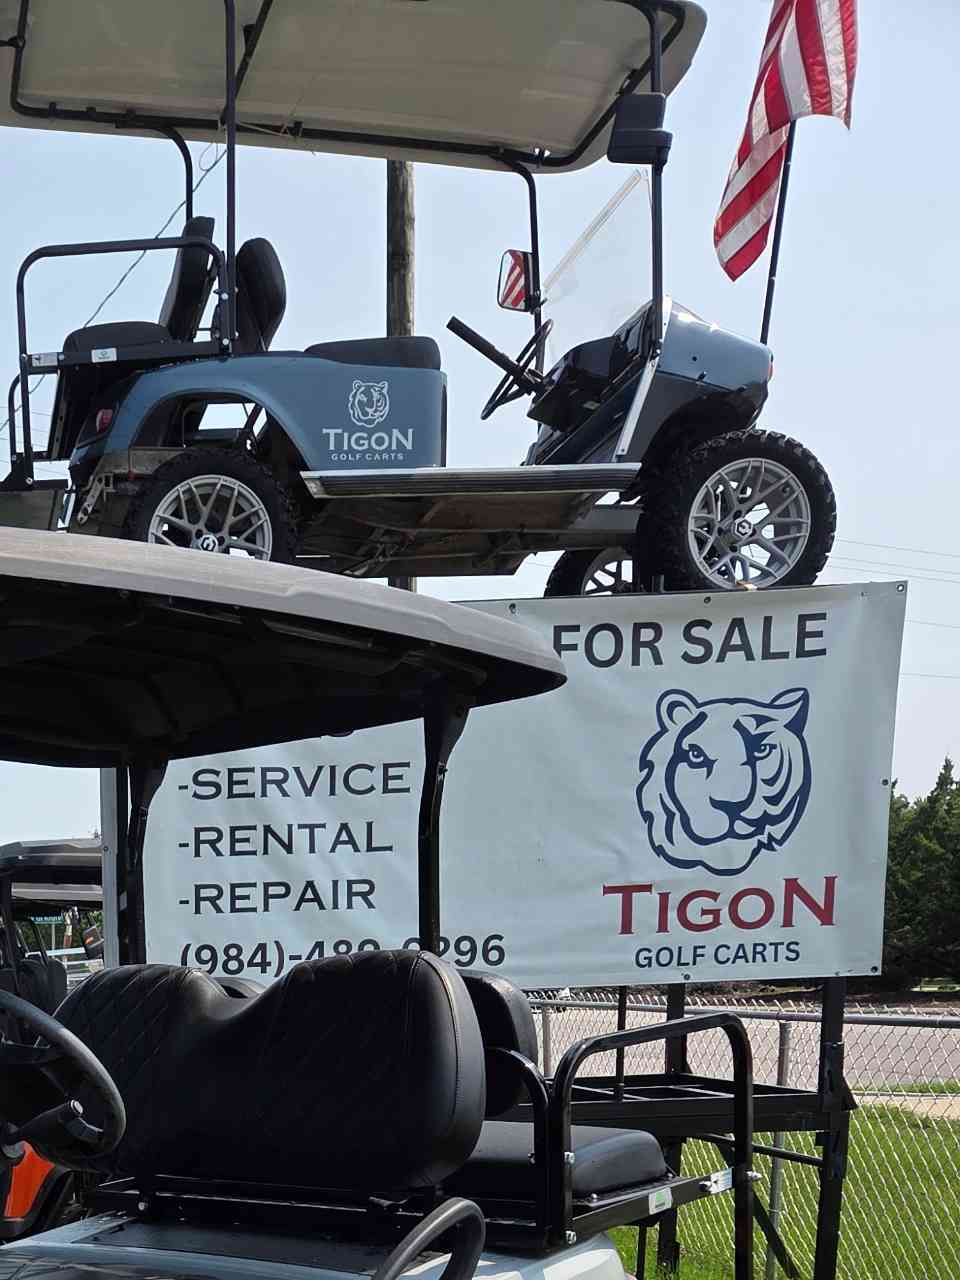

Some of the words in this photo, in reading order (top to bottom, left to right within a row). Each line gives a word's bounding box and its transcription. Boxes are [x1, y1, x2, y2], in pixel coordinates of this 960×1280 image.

[322, 428, 414, 450] TIGON
[331, 453, 362, 461] GOLF
[365, 453, 404, 461] CARTS
[552, 621, 664, 668] FOR
[681, 612, 827, 665] SALE
[178, 761, 411, 800] -SERVICE
[178, 821, 393, 858] -RENTAL
[178, 879, 376, 914] -REPAIR
[602, 875, 838, 935] TIGON
[635, 945, 706, 968] GOLF
[713, 941, 800, 965] CARTS
